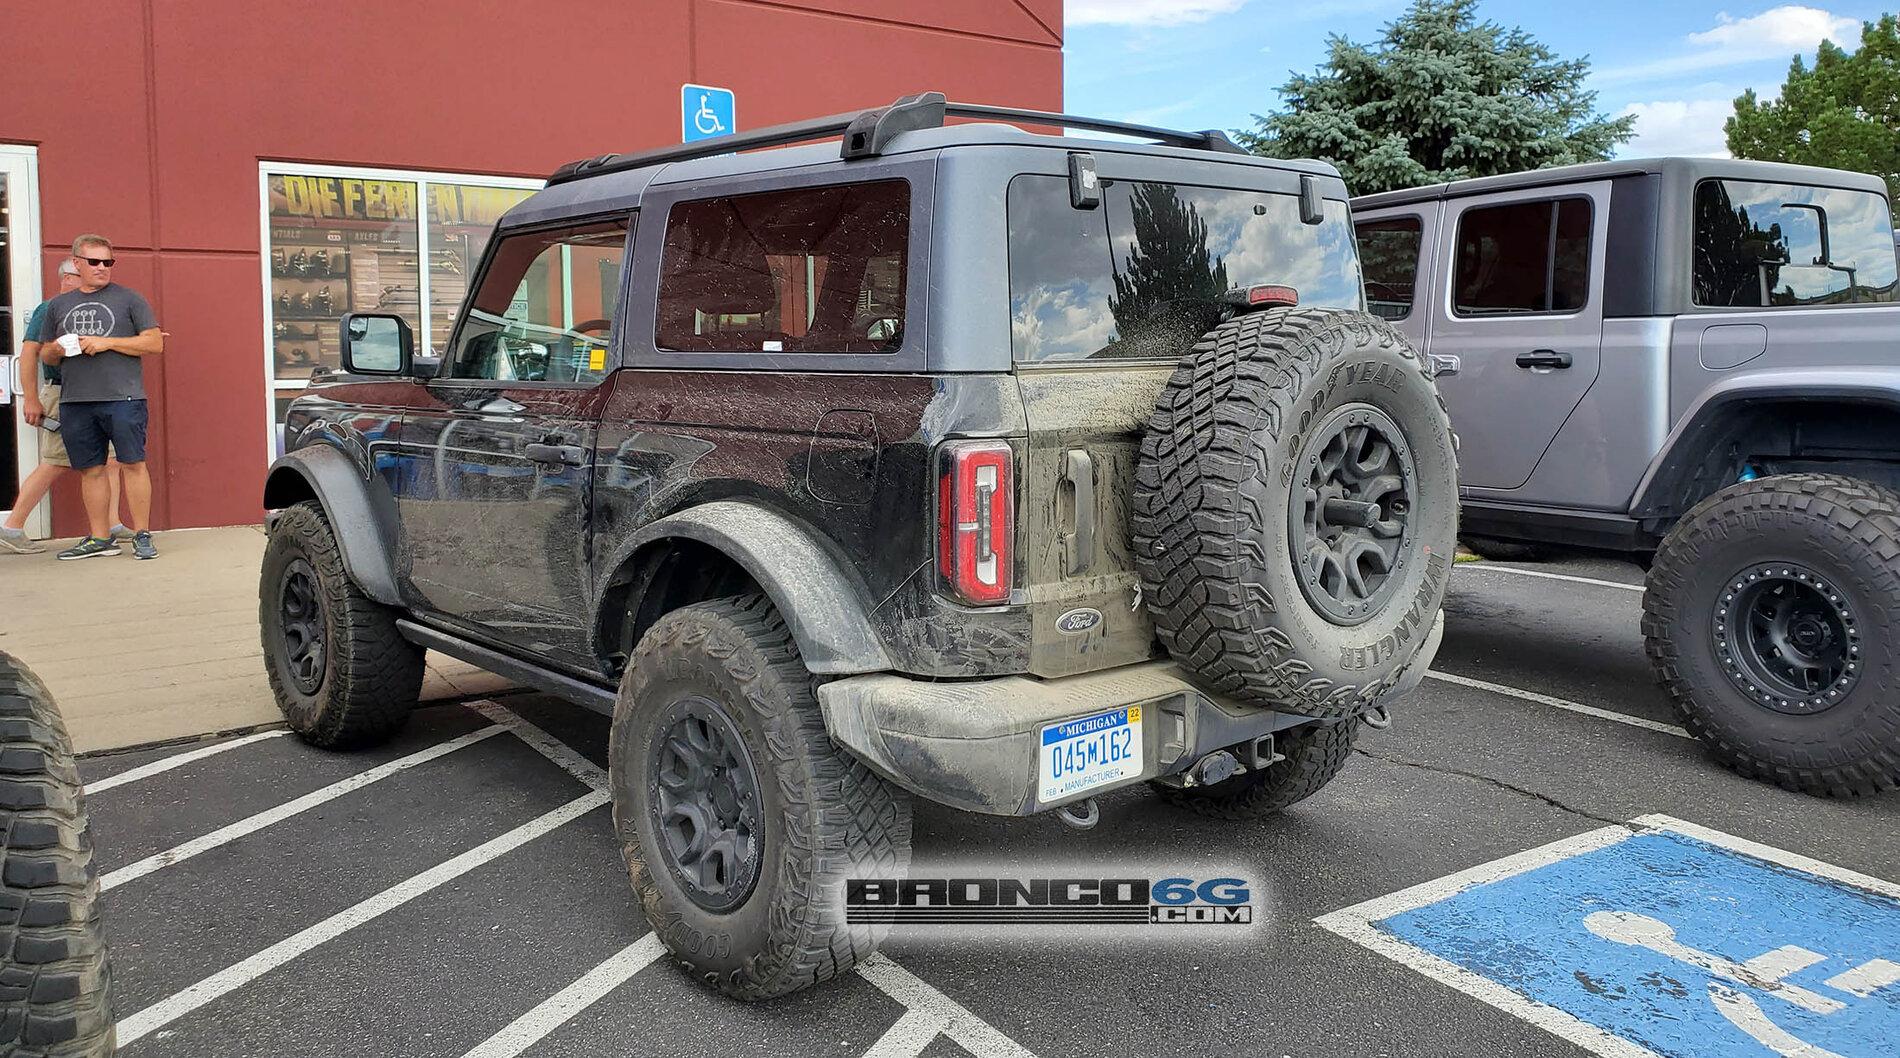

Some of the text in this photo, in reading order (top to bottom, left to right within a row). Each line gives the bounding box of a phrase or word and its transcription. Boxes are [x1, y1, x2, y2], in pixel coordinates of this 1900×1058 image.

[1067, 612, 1094, 630] Ford
[1340, 552, 1446, 672] WRANGLER
[1065, 713, 1118, 737] MICHIGAN
[1130, 708, 1140, 718] 22
[1052, 727, 1132, 779] 045M162
[1064, 768, 1120, 792] MANUFACTURER
